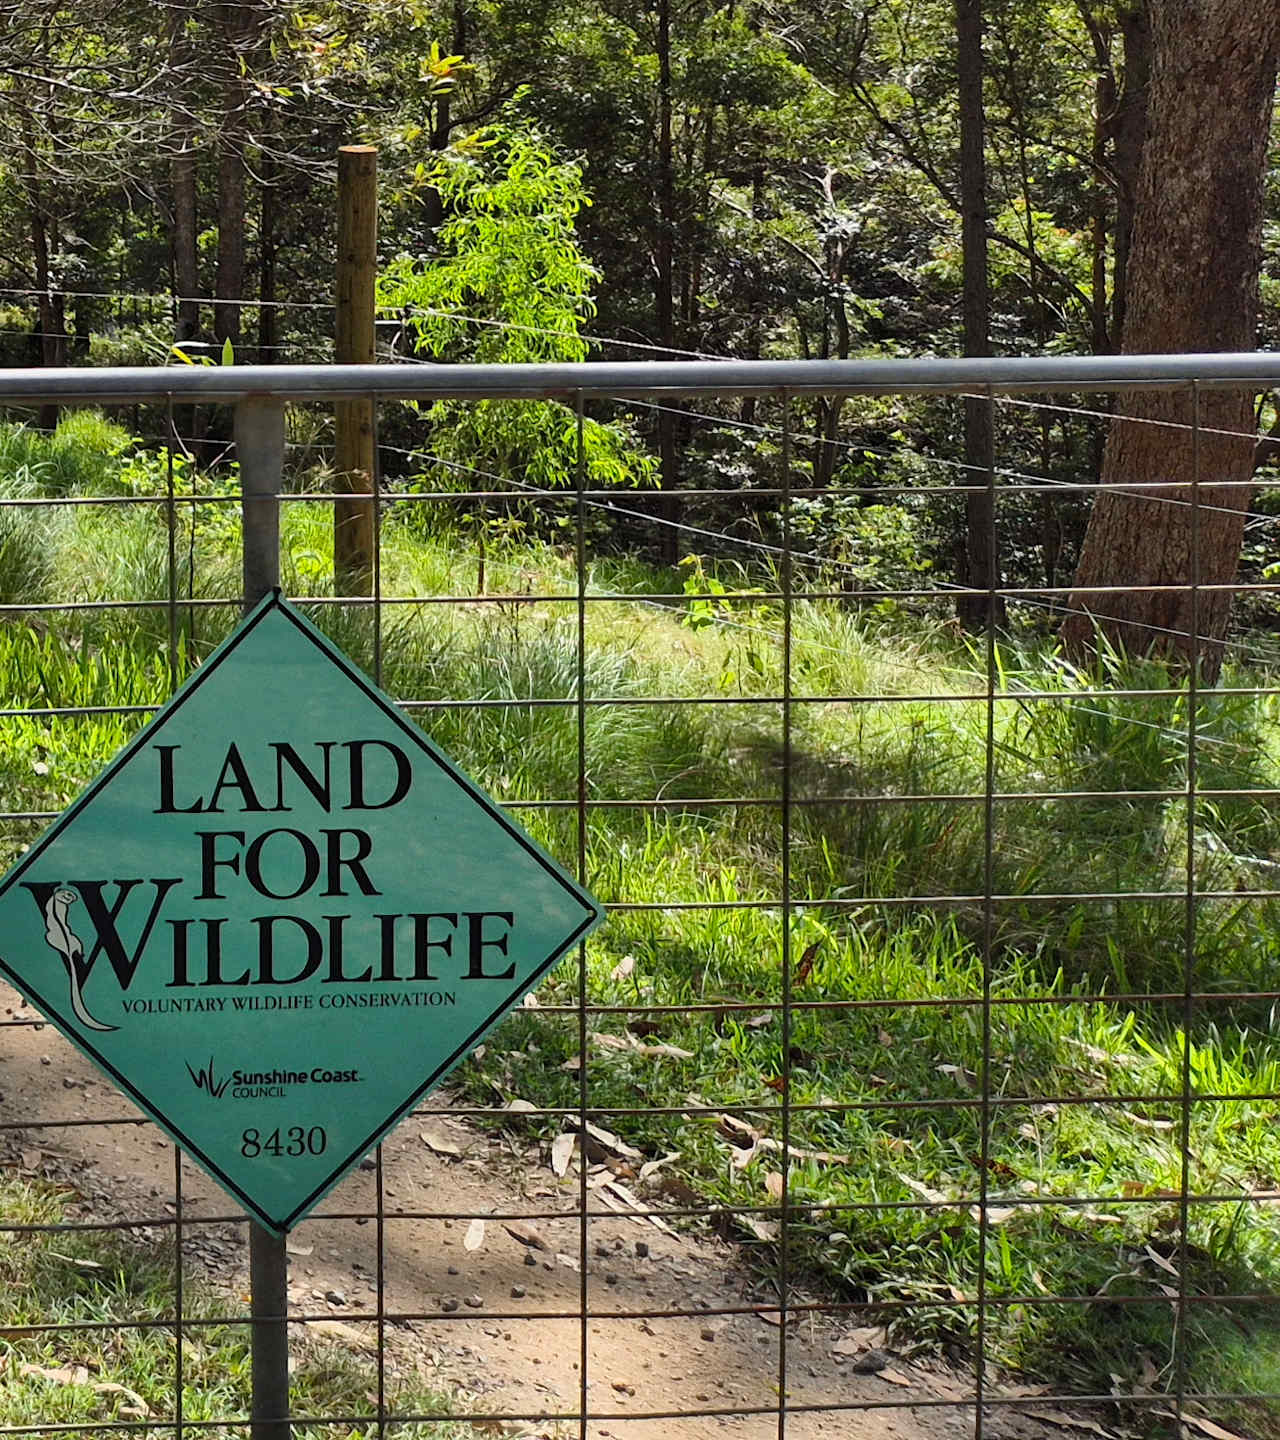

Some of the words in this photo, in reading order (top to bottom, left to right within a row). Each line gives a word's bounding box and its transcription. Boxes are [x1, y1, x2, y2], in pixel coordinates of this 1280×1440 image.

[152, 739, 412, 814] LAND
[193, 828, 382, 901] FOR
[20, 877, 517, 992] WILDLIFE
[122, 997, 227, 1014] VOLUNTARY
[232, 995, 313, 1011] WILDLIFE
[318, 992, 456, 1009] CONSERVATION
[232, 1068, 308, 1085] Sunshine
[310, 1068, 359, 1083] Coast
[232, 1087, 286, 1098] COUNCIL
[241, 1127, 327, 1158] 8430
